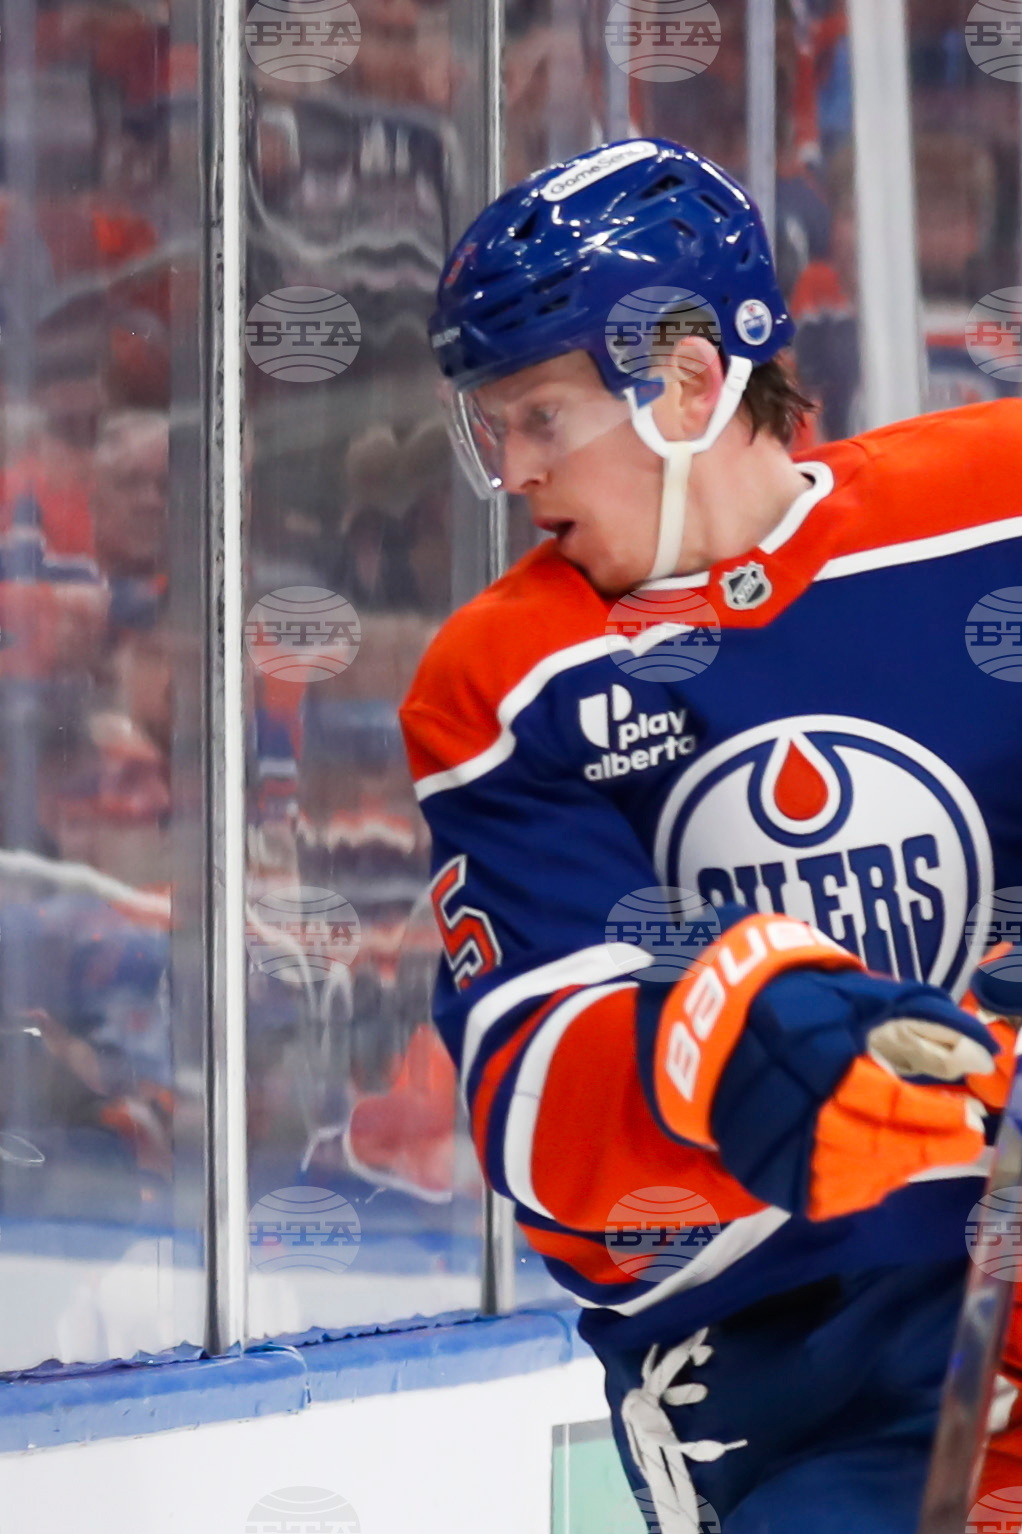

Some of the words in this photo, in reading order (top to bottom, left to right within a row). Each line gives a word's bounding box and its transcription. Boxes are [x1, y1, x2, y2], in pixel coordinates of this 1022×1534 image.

[618, 709, 686, 750] play
[584, 735, 696, 781] alberta
[430, 854, 501, 992] 5
